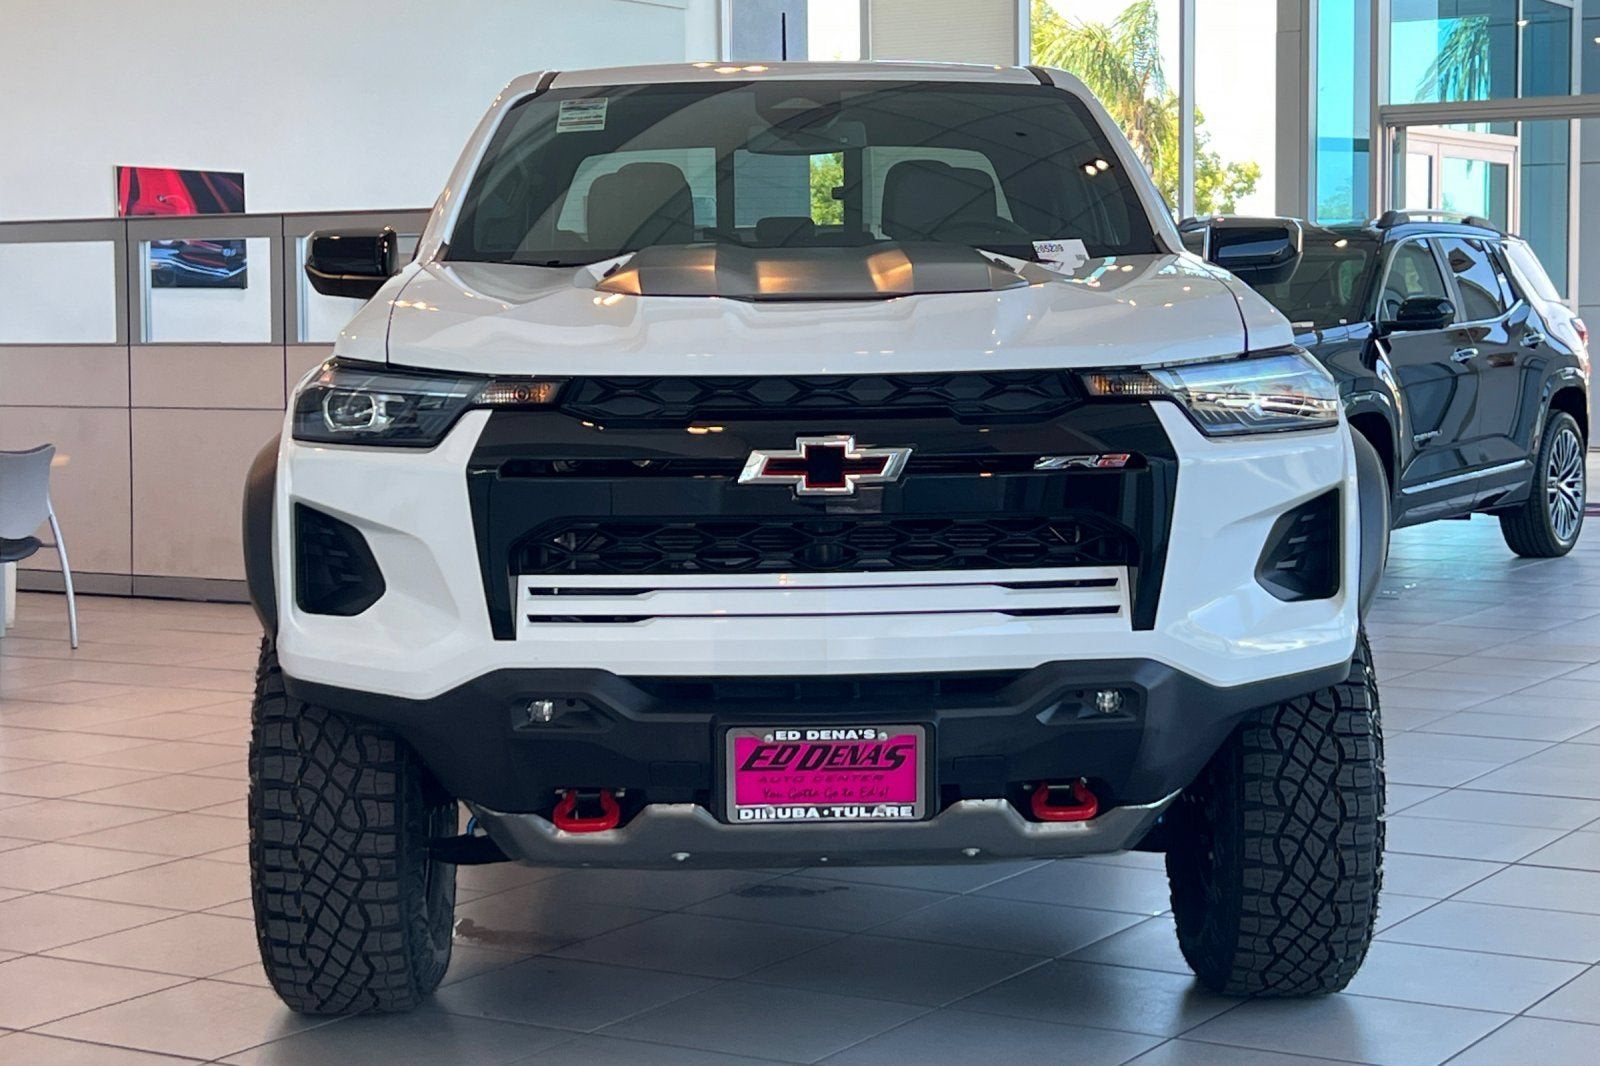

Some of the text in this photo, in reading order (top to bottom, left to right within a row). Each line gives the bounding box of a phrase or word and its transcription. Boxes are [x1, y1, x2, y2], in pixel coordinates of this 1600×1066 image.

[775, 729, 876, 740] ED DENA'S
[740, 745, 802, 771] ED
[759, 774, 885, 783] AUTO CENTER
[763, 787, 783, 798] You
[824, 787, 839, 798] Go
[739, 806, 913, 819] DINUBA TULARE
